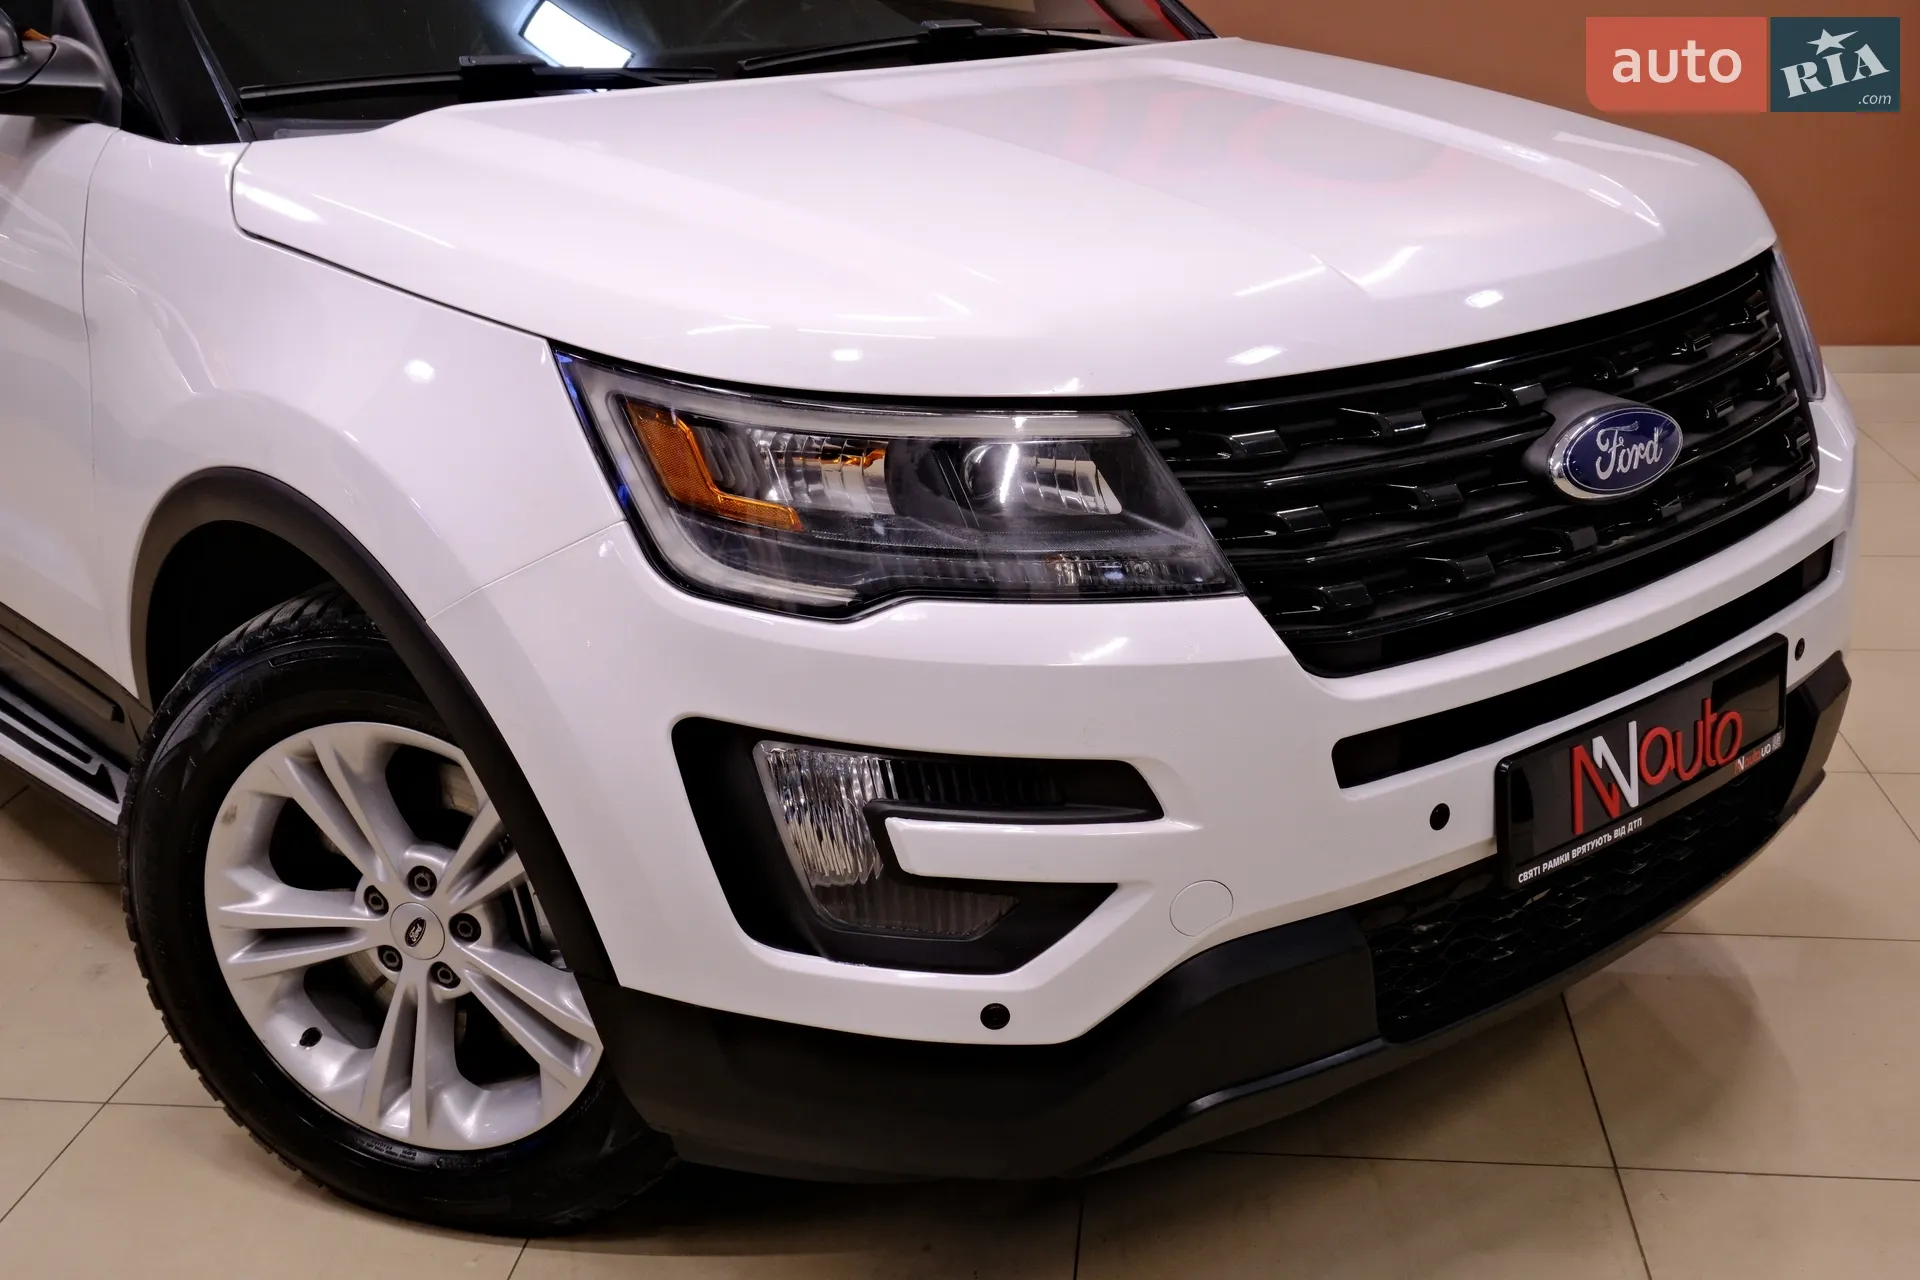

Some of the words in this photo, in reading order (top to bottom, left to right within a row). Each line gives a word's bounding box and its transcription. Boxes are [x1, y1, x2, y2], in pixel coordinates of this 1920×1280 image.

[1595, 421, 1663, 480] Ford
[1518, 865, 1541, 883] СВЯТІ
[1542, 852, 1570, 873] РАМКИ
[1571, 833, 1613, 859] ВРЯТУЮТЬ
[1613, 825, 1626, 839] ВІД
[1627, 817, 1643, 833] ДТП
